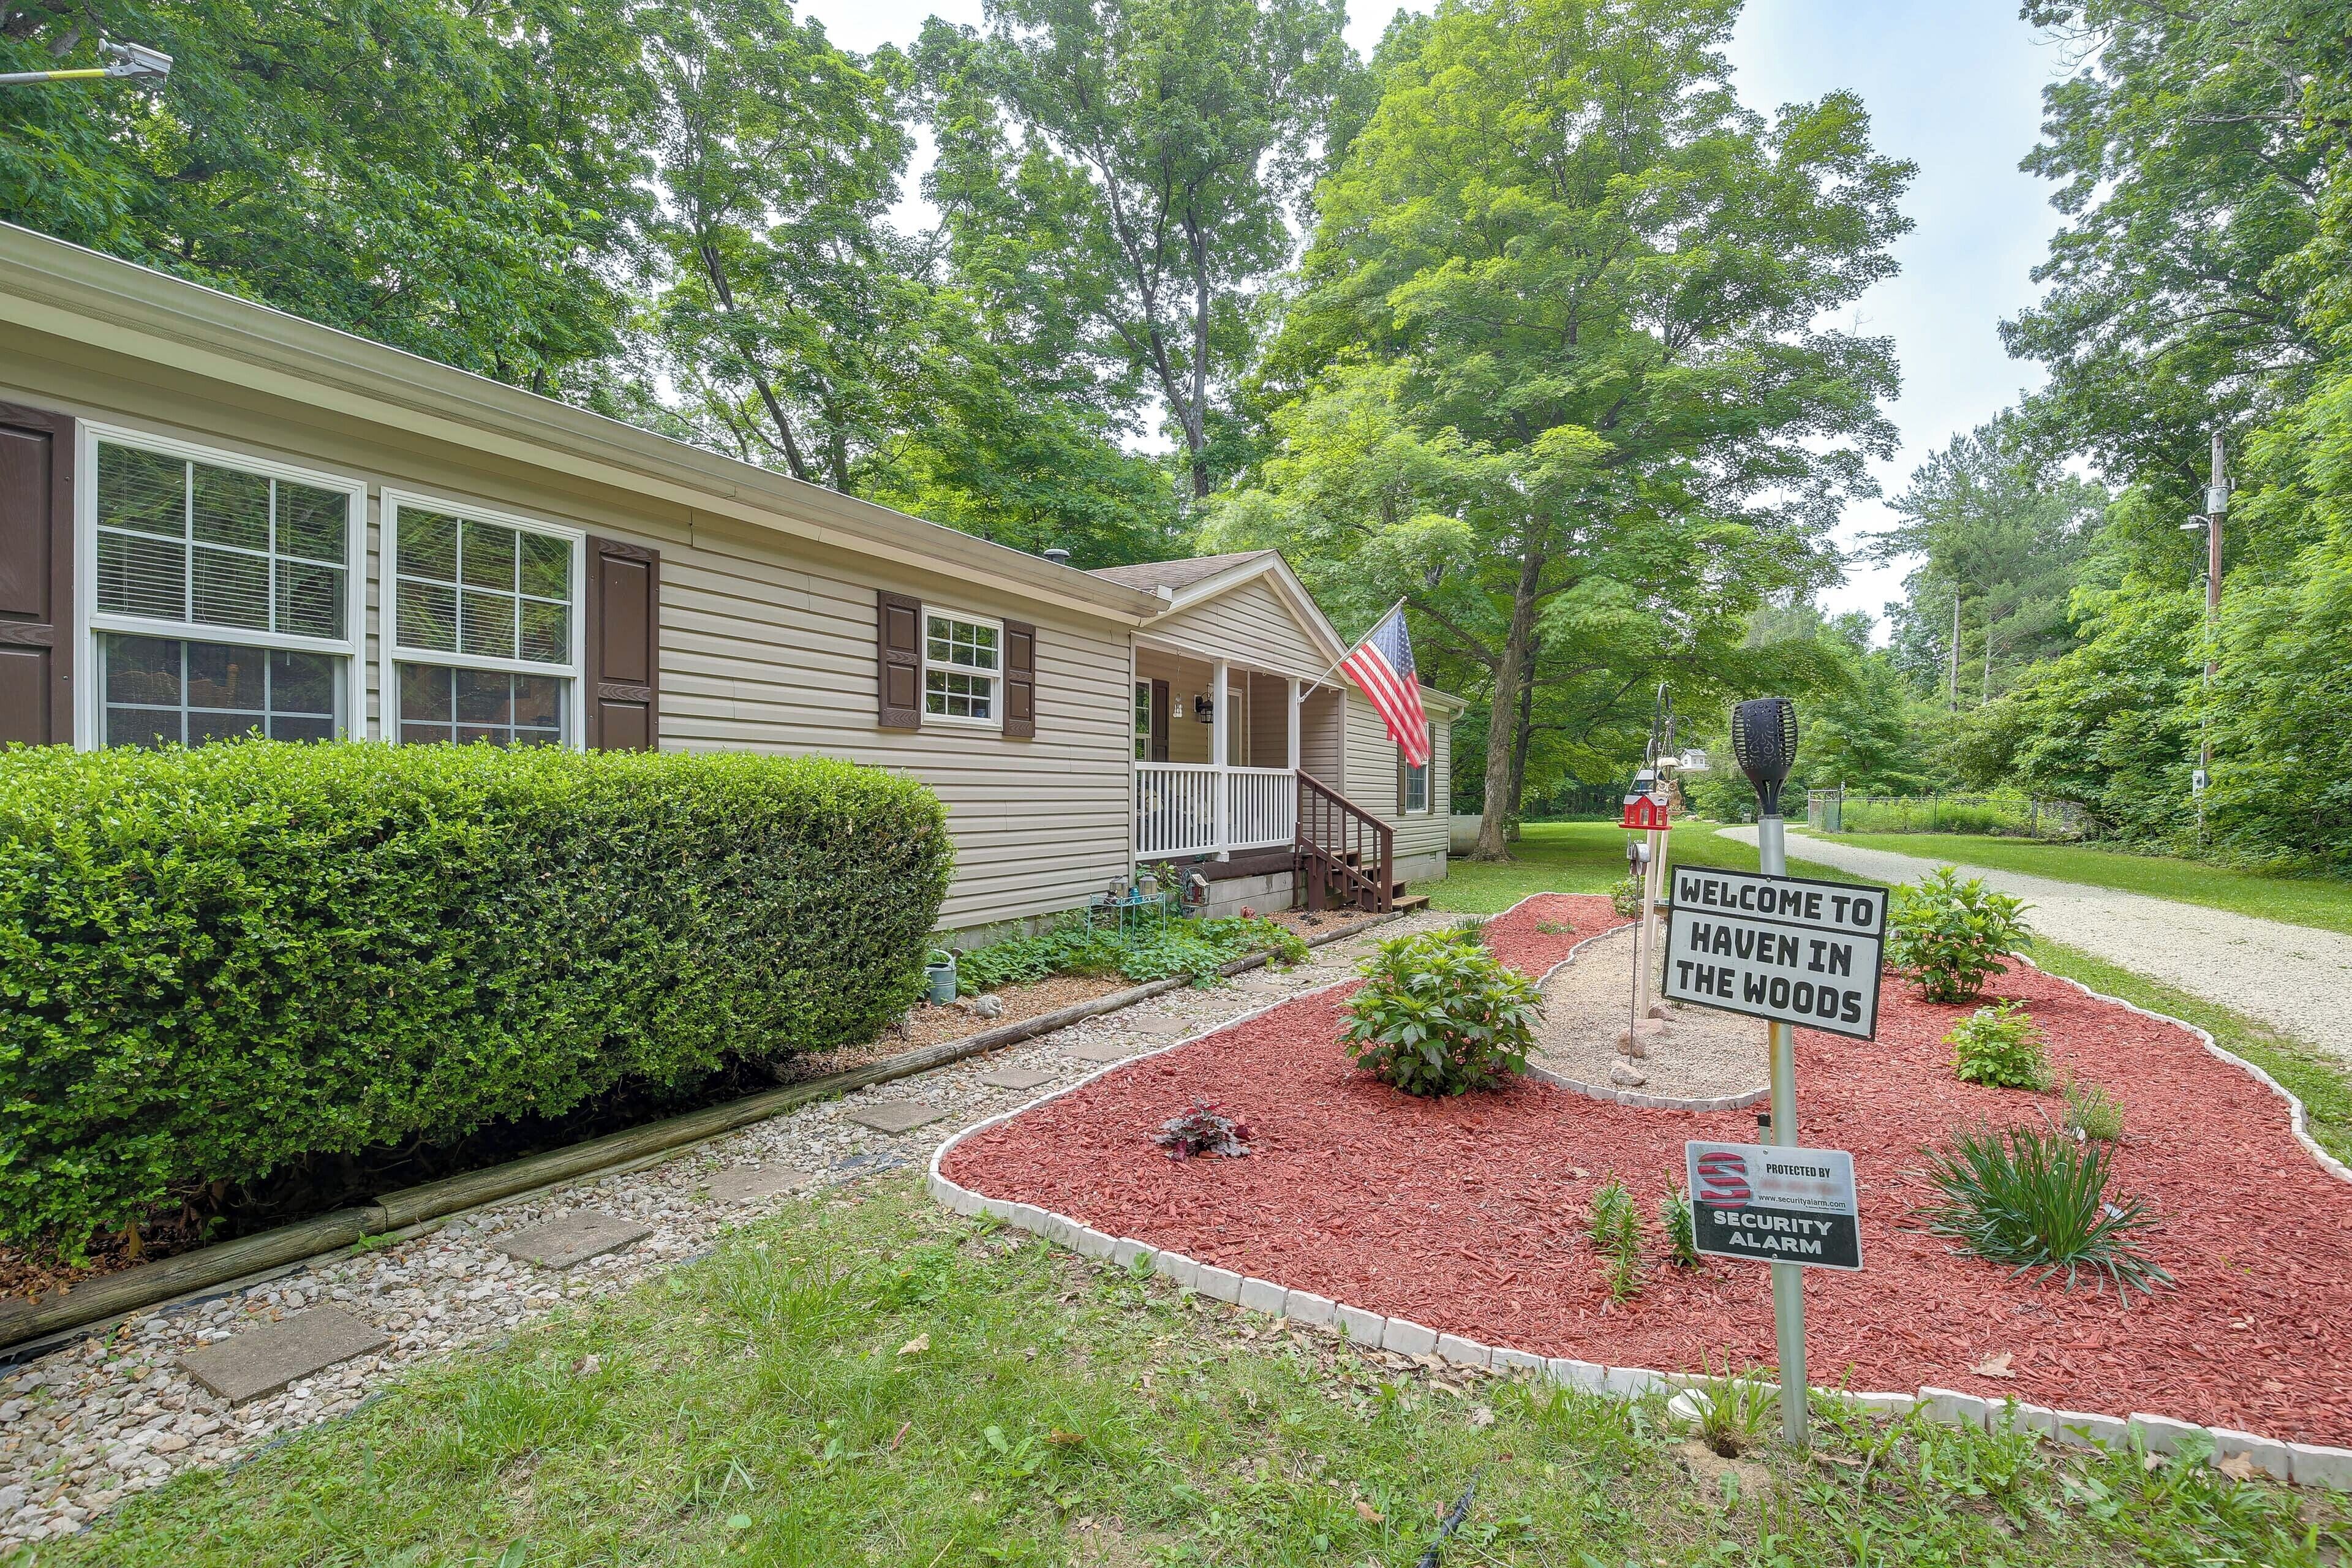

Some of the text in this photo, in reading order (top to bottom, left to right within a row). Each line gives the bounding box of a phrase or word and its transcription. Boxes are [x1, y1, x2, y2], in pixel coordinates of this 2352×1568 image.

[1681, 876, 1873, 927] WELCOME TO
[1691, 922, 1852, 977] HAVEN IN
[1676, 960, 1862, 1024] THE WOODS
[1766, 1164, 1830, 1178] PROTECTED BY
[1758, 1195, 1845, 1208] www.securityalarm.com
[1714, 1210, 1833, 1236] SECURITY
[1728, 1231, 1822, 1254] ALARM
